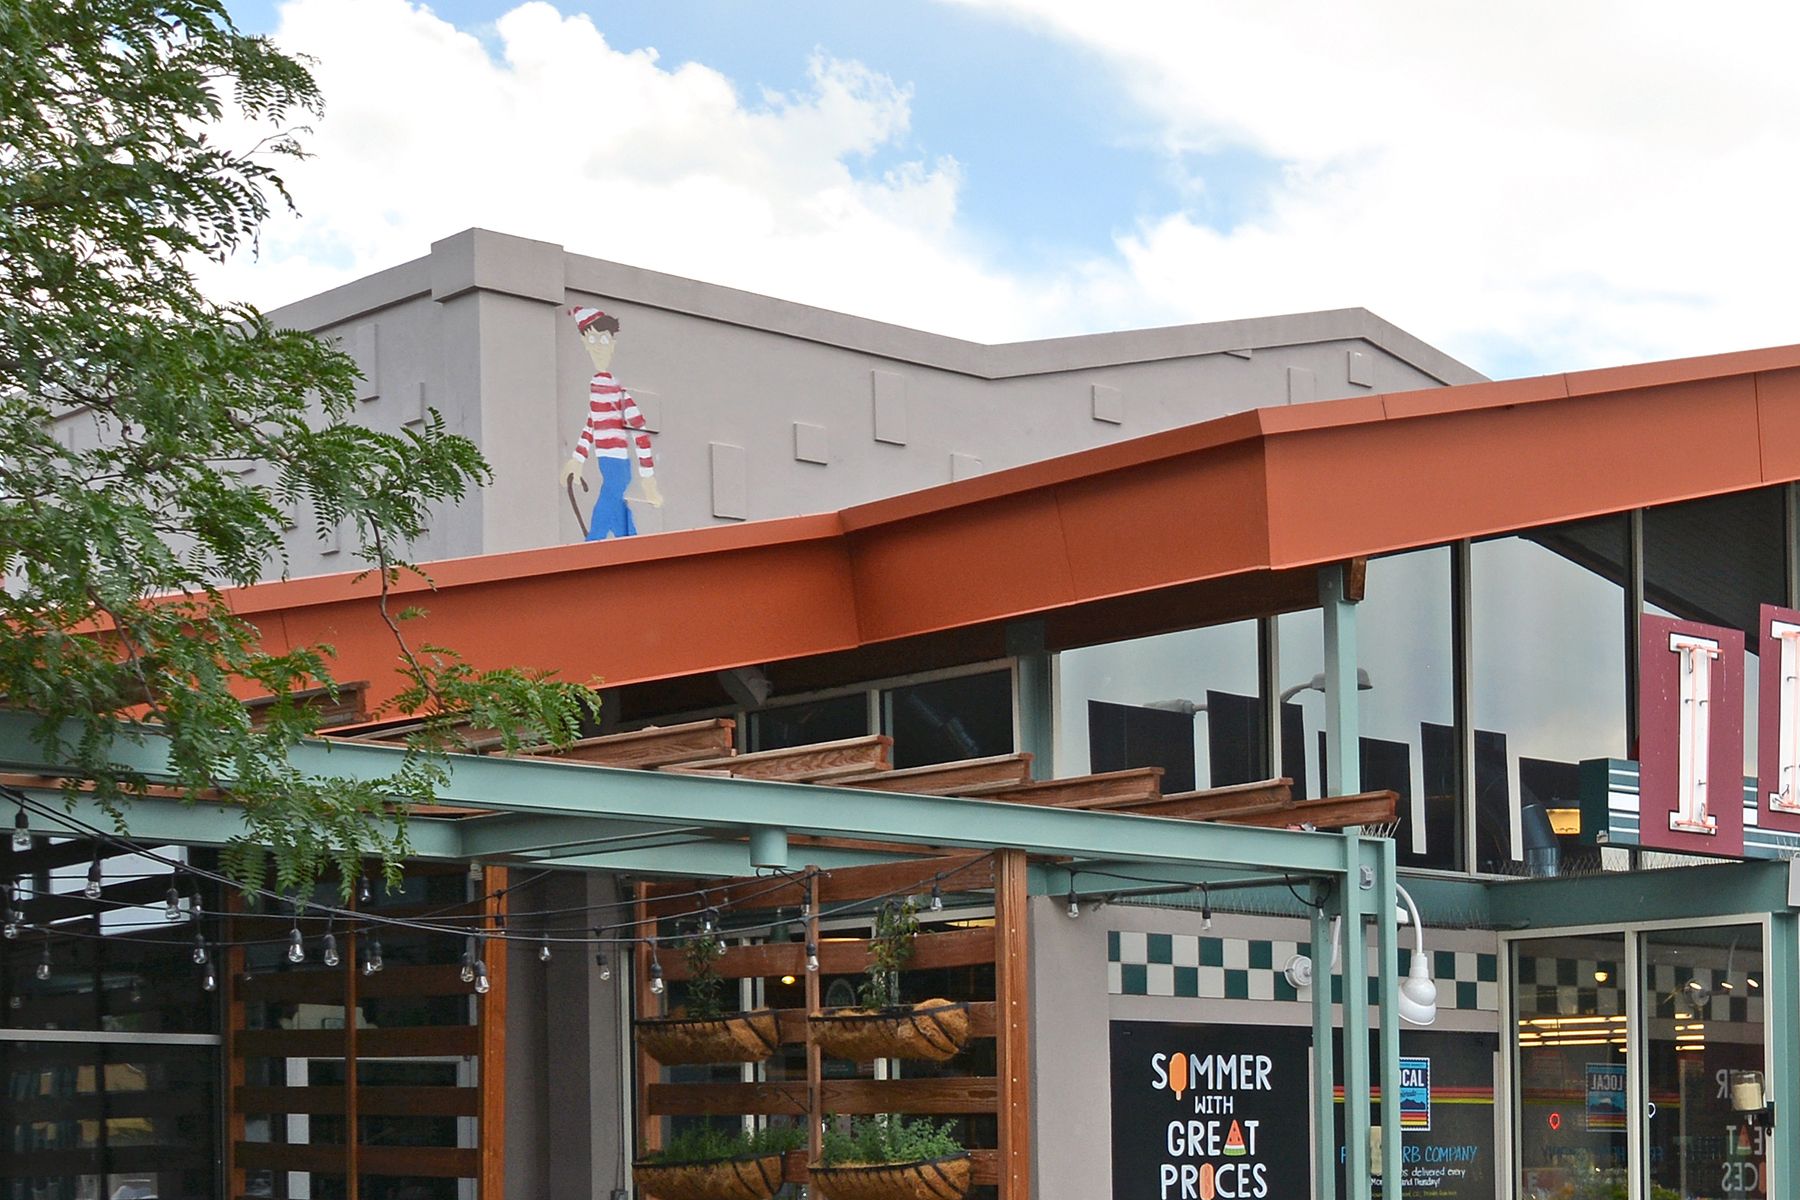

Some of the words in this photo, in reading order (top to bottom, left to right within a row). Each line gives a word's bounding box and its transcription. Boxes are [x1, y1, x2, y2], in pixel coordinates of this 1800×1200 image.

[1151, 1052, 1272, 1100] SMMER
[1400, 1069, 1425, 1087] CAL
[1194, 1095, 1234, 1115] WITH
[1425, 1146, 1477, 1163] COMPANY
